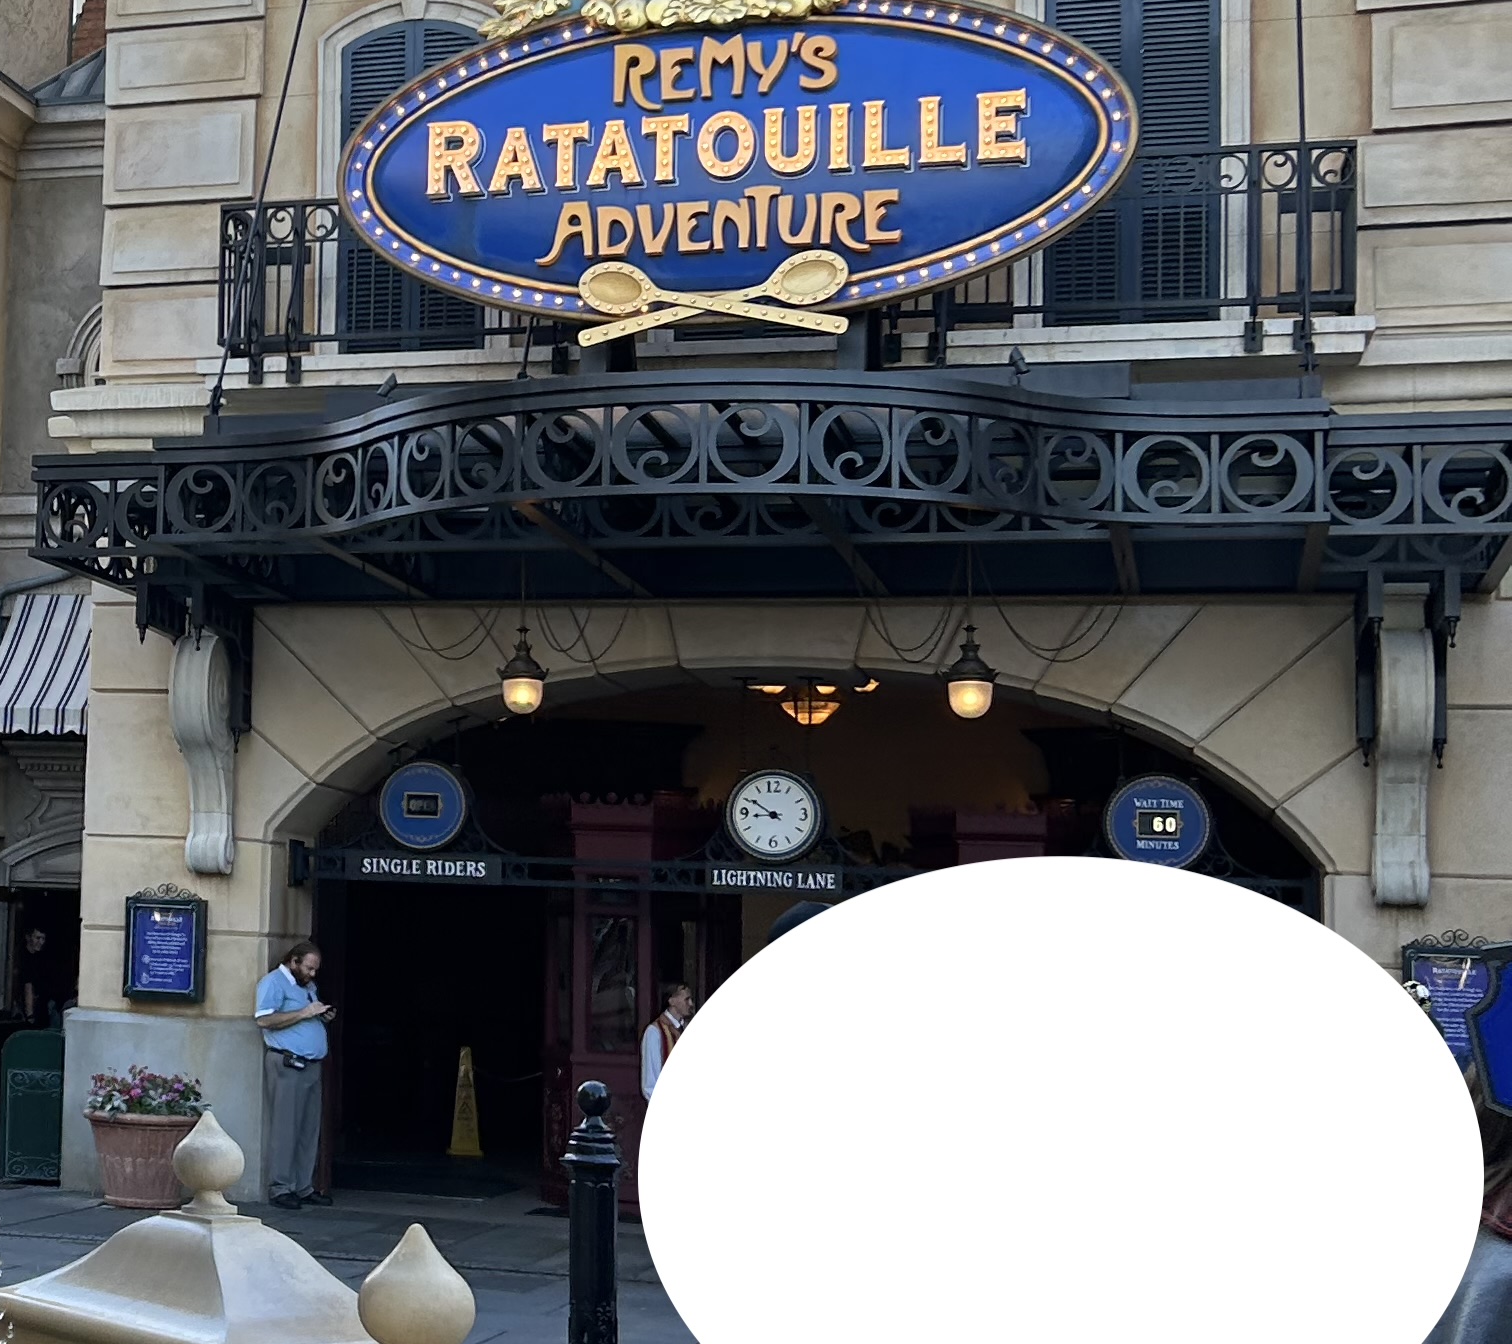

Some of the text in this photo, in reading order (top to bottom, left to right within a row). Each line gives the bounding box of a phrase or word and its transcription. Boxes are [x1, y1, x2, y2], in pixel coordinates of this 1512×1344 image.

[613, 32, 838, 111] REMY'S
[426, 87, 1030, 200] RATATOUILLE
[535, 185, 902, 266] ADVENTURE
[766, 780, 781, 793] 12
[1133, 797, 1184, 809] WAIT TIME
[739, 806, 749, 820] 9
[799, 807, 808, 821] 3
[1152, 816, 1176, 832] 60
[768, 835, 778, 848] 6
[1136, 839, 1179, 850] MINUTES
[361, 857, 486, 877] SINGLE RIDERS
[712, 869, 836, 889] LIGHTNING LANE
